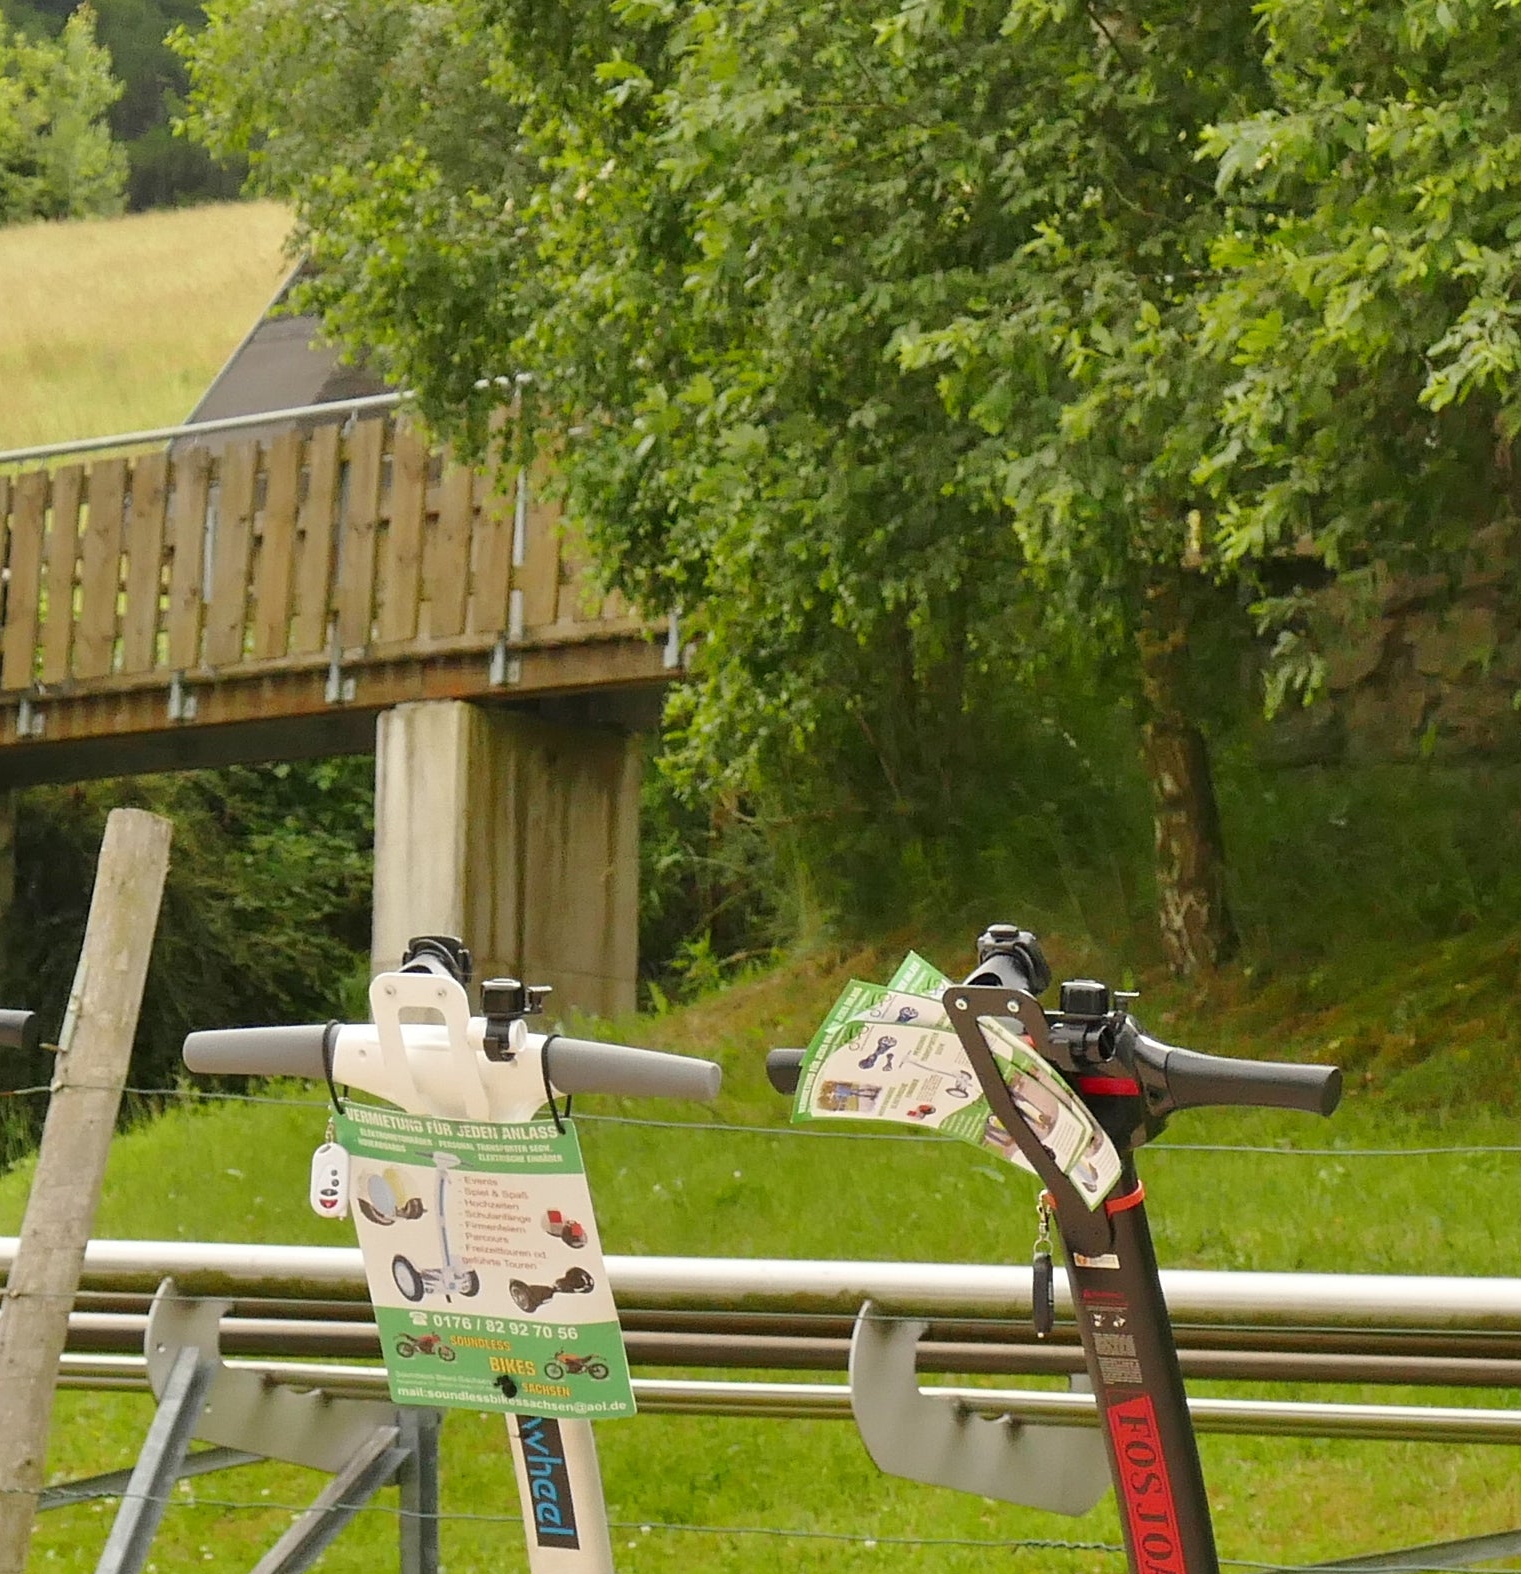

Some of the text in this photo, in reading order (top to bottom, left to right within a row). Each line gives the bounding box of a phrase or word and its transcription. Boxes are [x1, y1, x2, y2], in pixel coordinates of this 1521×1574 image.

[345, 1106, 558, 1140] VERMIETUNG FÜR JEDEN ANLASS
[433, 1315, 472, 1331] 0176
[485, 1320, 505, 1334] 82
[509, 1321, 529, 1336] 92
[532, 1324, 553, 1339] 70
[557, 1326, 578, 1340] 56
[450, 1335, 512, 1351] SOUNDLESS
[488, 1356, 537, 1377] BIKES
[522, 1382, 572, 1397] SACHSEN
